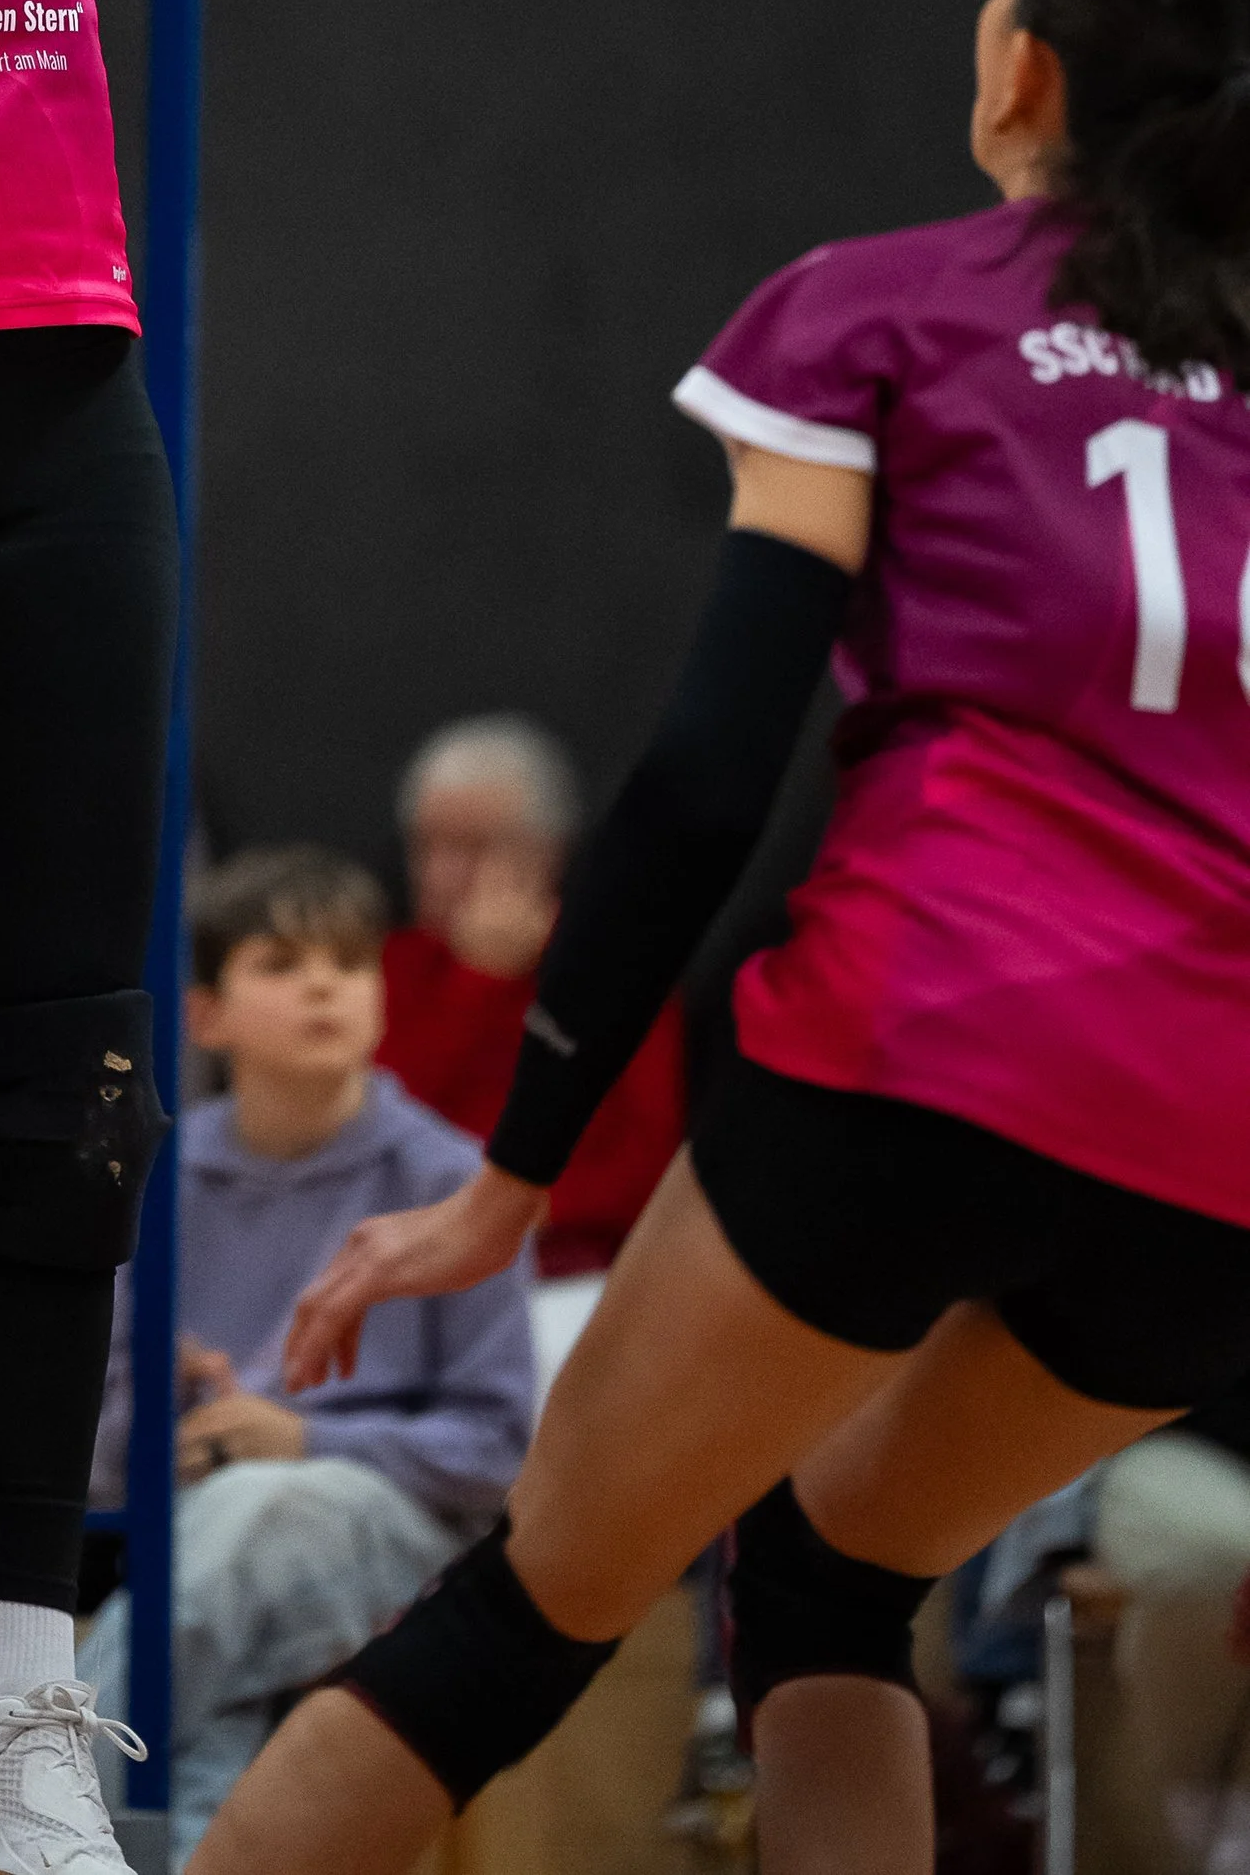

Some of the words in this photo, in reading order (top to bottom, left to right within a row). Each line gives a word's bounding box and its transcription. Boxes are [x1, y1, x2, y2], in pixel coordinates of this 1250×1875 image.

[14, 54, 37, 71] am
[36, 50, 68, 72] Main
[1084, 418, 1250, 714] 1
